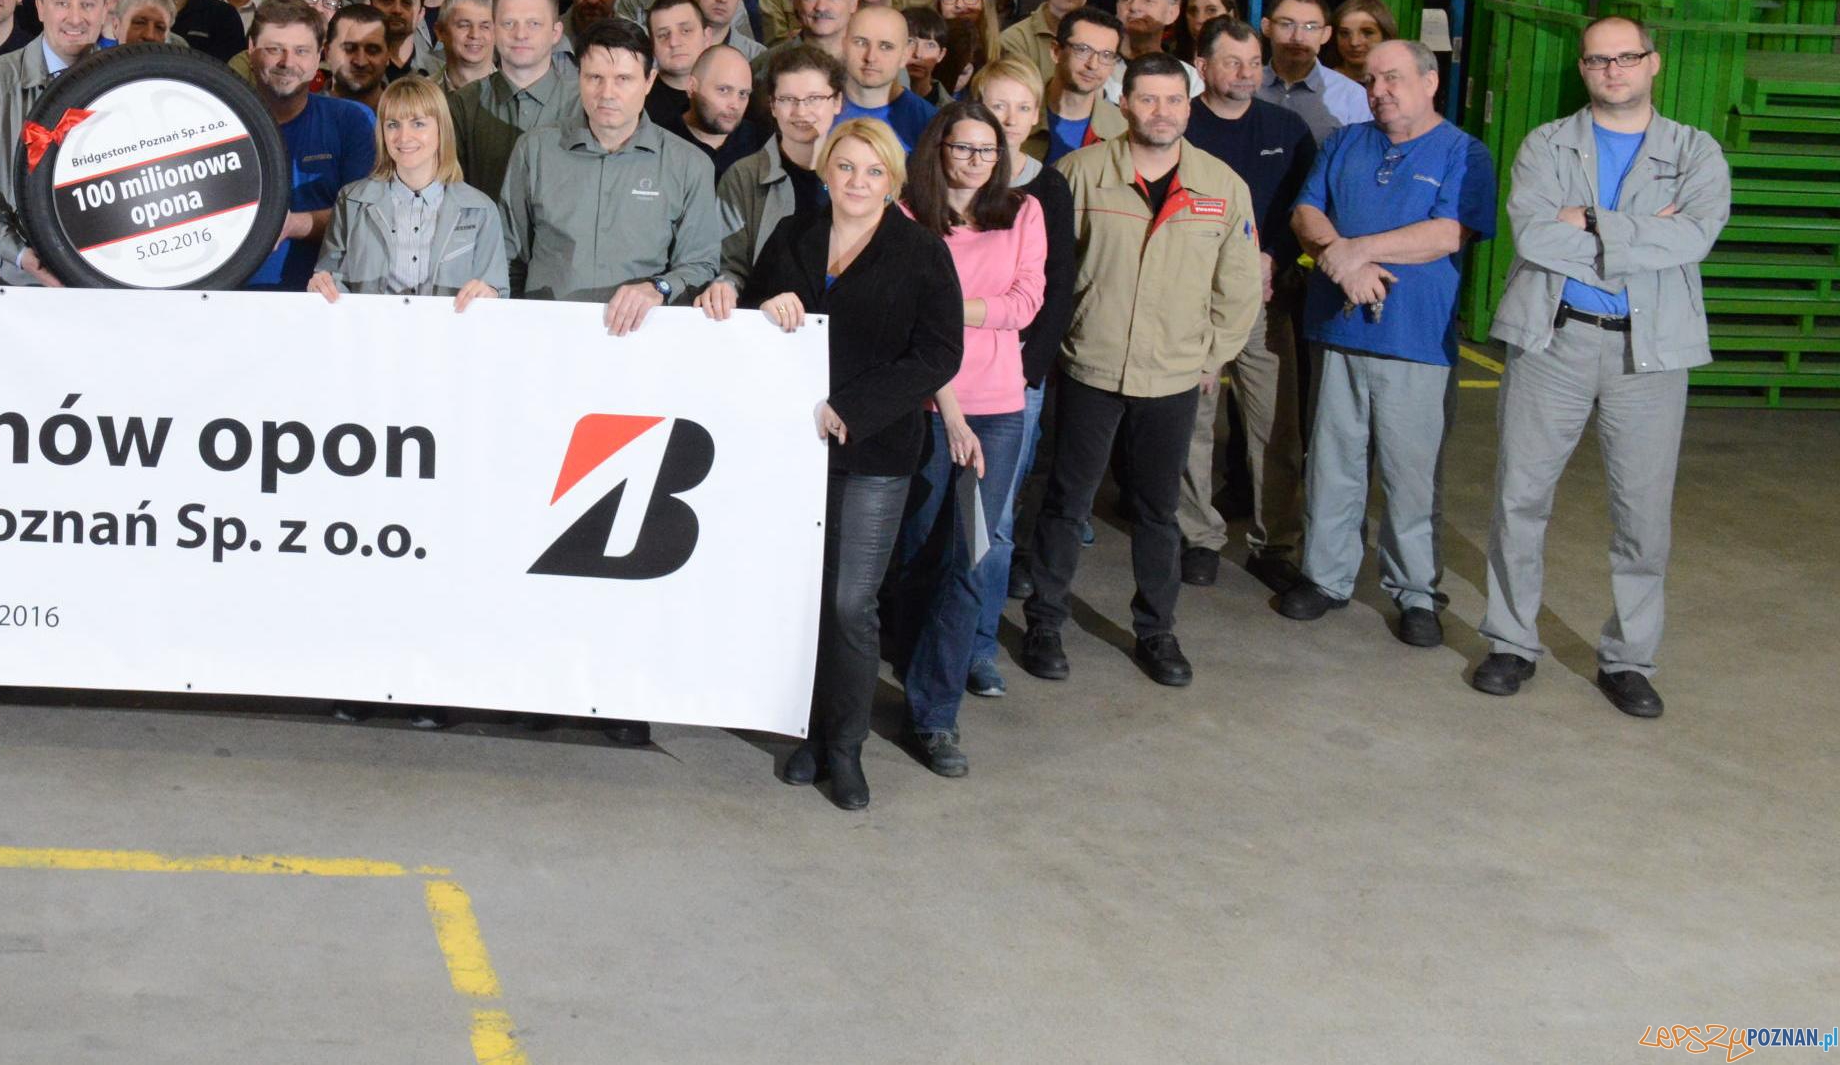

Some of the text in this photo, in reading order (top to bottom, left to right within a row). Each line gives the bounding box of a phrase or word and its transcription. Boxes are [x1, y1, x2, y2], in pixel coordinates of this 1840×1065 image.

[72, 120, 228, 167] Bridgestone Poznań Sp. z o.o.
[72, 151, 242, 212] 100 milionowa
[131, 190, 203, 228] opona
[136, 227, 212, 260] 5.02.2016
[198, 418, 436, 494] opon
[176, 503, 262, 563] Sp.
[278, 520, 307, 554] z
[323, 521, 427, 560] o.o.
